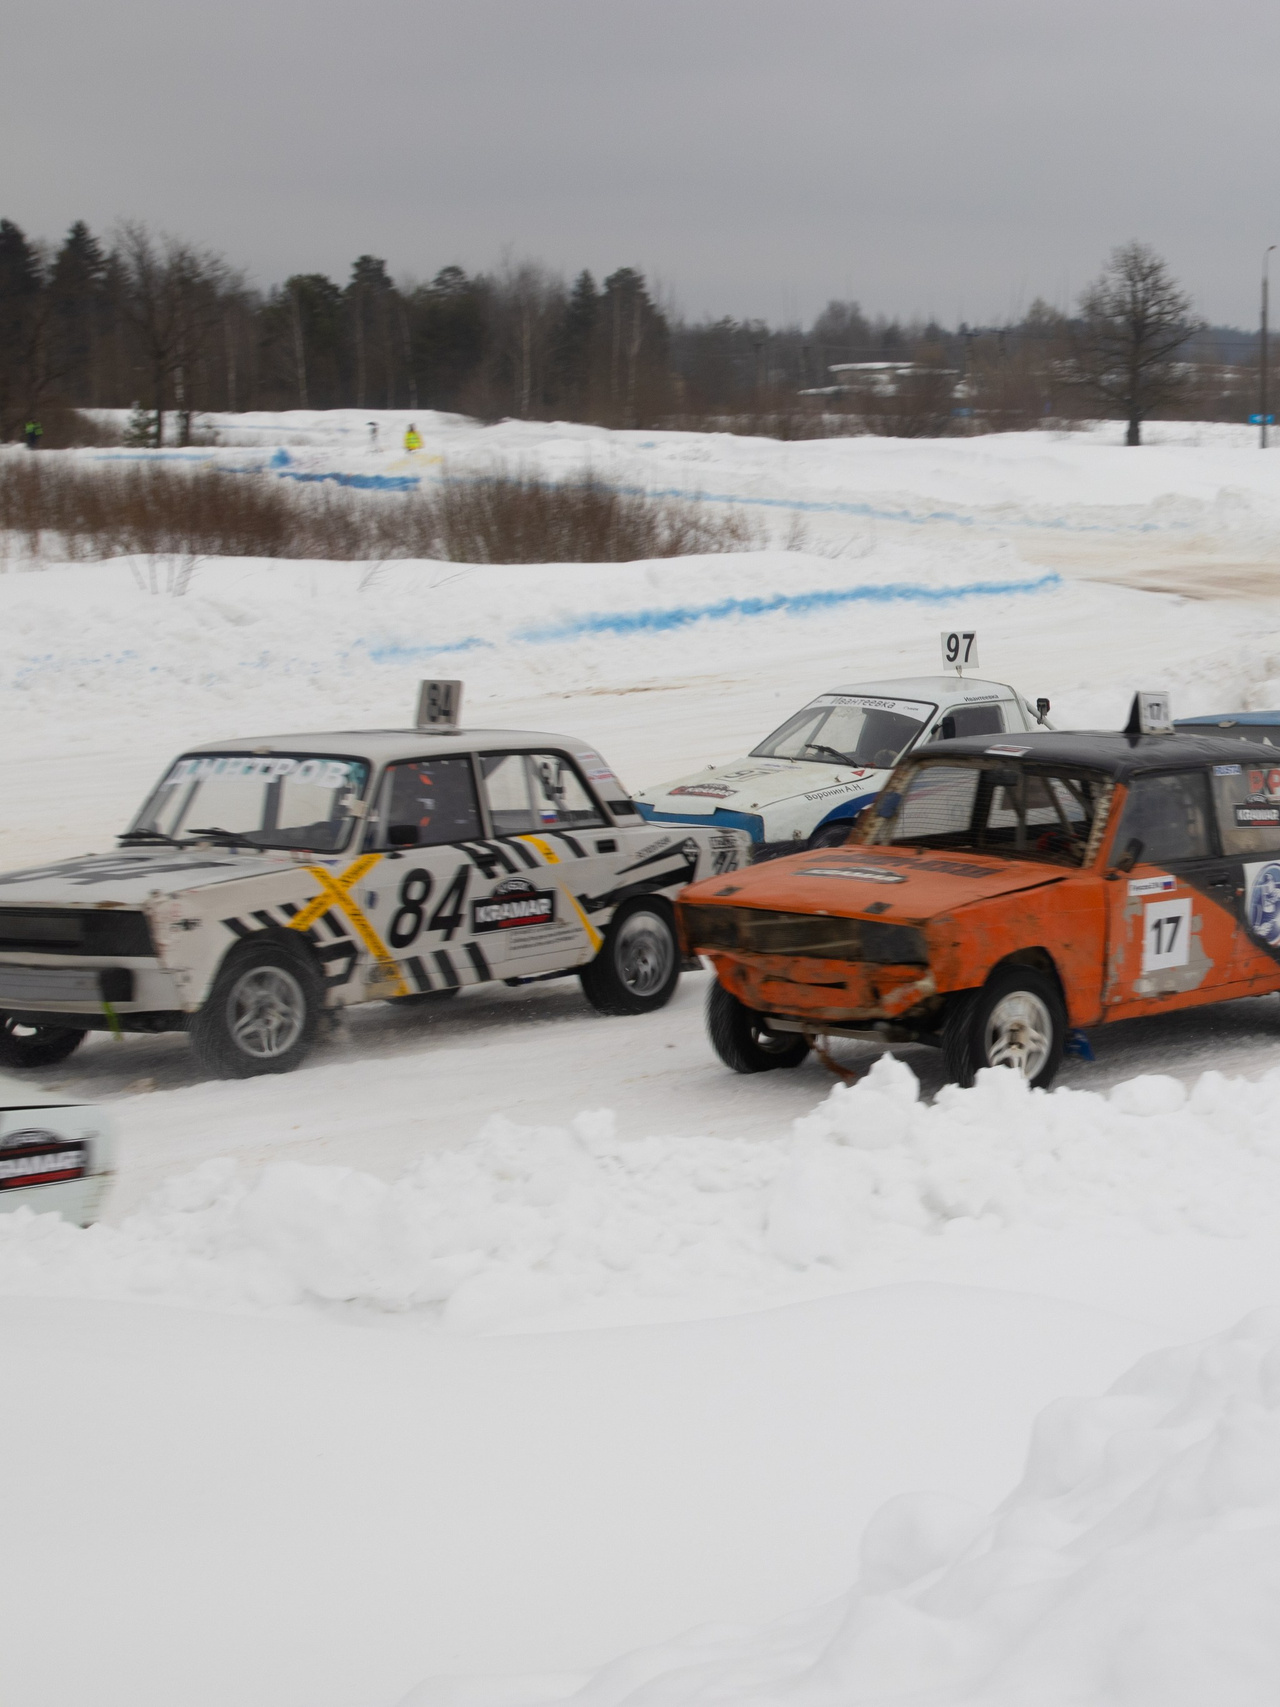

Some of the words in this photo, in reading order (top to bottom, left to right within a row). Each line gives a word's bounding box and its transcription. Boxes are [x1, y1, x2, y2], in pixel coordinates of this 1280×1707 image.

[946, 633, 975, 663] 97
[428, 682, 453, 723] 84
[829, 696, 896, 709] Ивантеевка
[964, 694, 999, 702] Ивантеевка
[805, 787, 845, 801] Воронин
[845, 783, 865, 793] А.Н.
[1236, 809, 1280, 820] KRAMAR
[389, 864, 471, 948] 84
[475, 899, 552, 923] KRAMAR
[1151, 915, 1182, 955] 17
